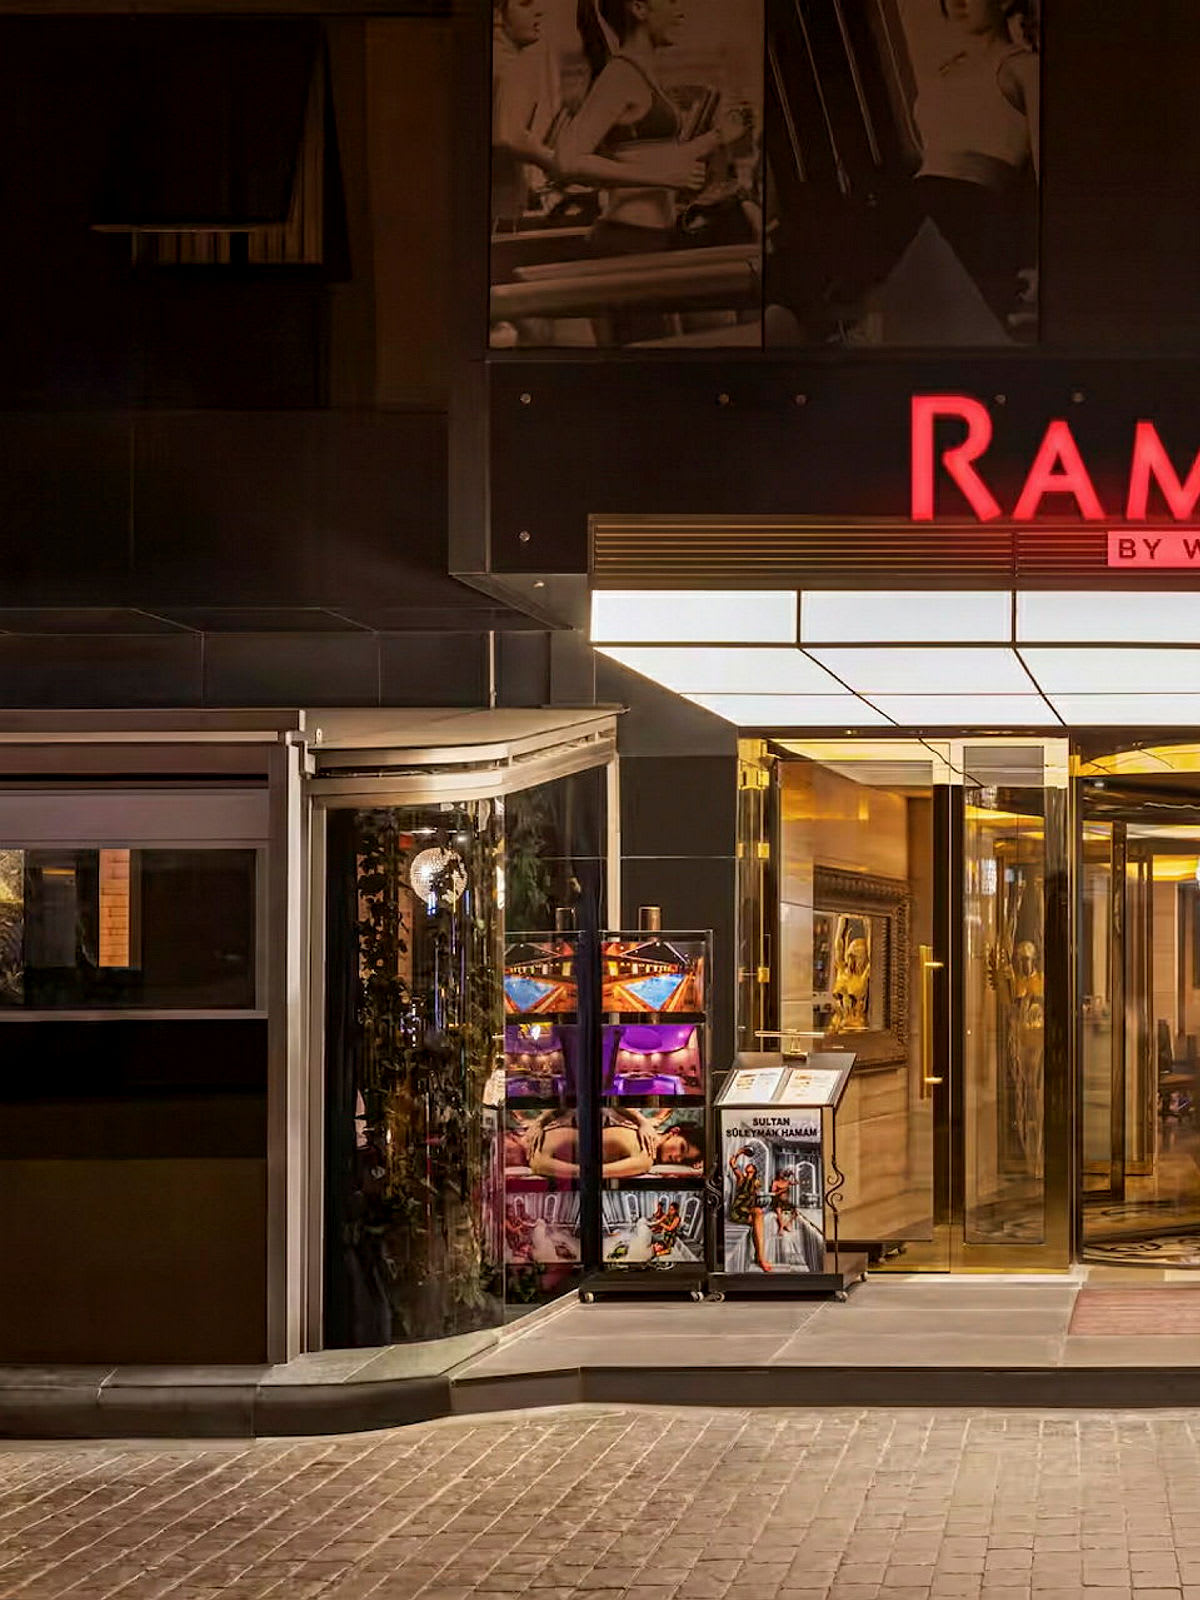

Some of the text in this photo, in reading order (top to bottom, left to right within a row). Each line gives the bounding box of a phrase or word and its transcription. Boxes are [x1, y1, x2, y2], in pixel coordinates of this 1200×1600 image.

[1118, 538, 1163, 560] BY
[752, 1117, 790, 1126] SULTAN
[725, 1127, 818, 1137] SÜLEYMAN HAMAM
